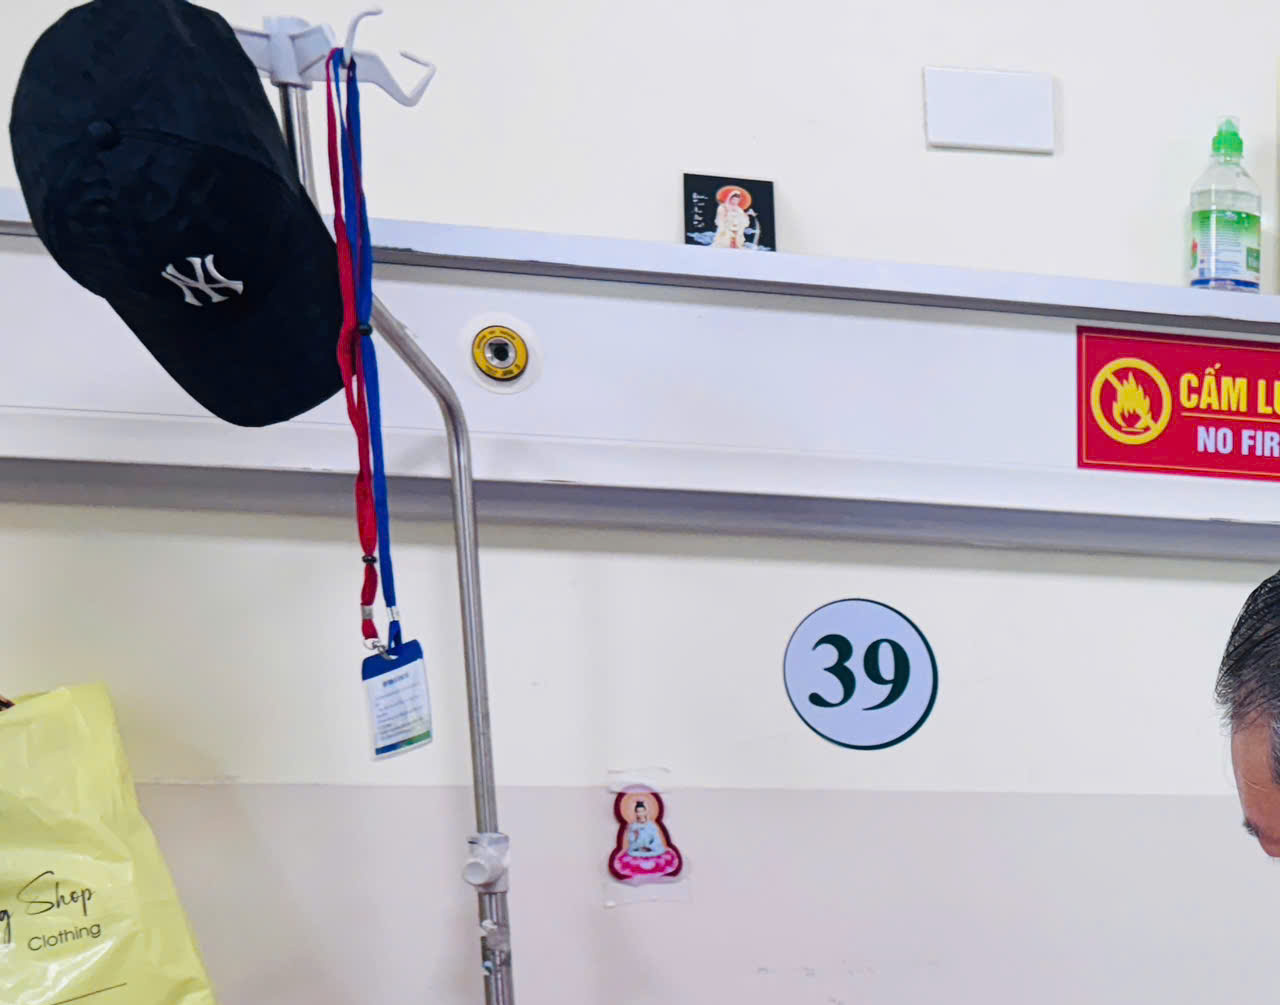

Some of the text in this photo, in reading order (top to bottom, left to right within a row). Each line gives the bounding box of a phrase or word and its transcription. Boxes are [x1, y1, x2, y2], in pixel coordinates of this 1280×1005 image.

[161, 254, 244, 306] NY
[1179, 362, 1248, 413] CẤM
[1197, 425, 1233, 454] NO
[808, 634, 910, 711] 39
[16, 870, 95, 916] Shop
[27, 924, 101, 951] Clothing
